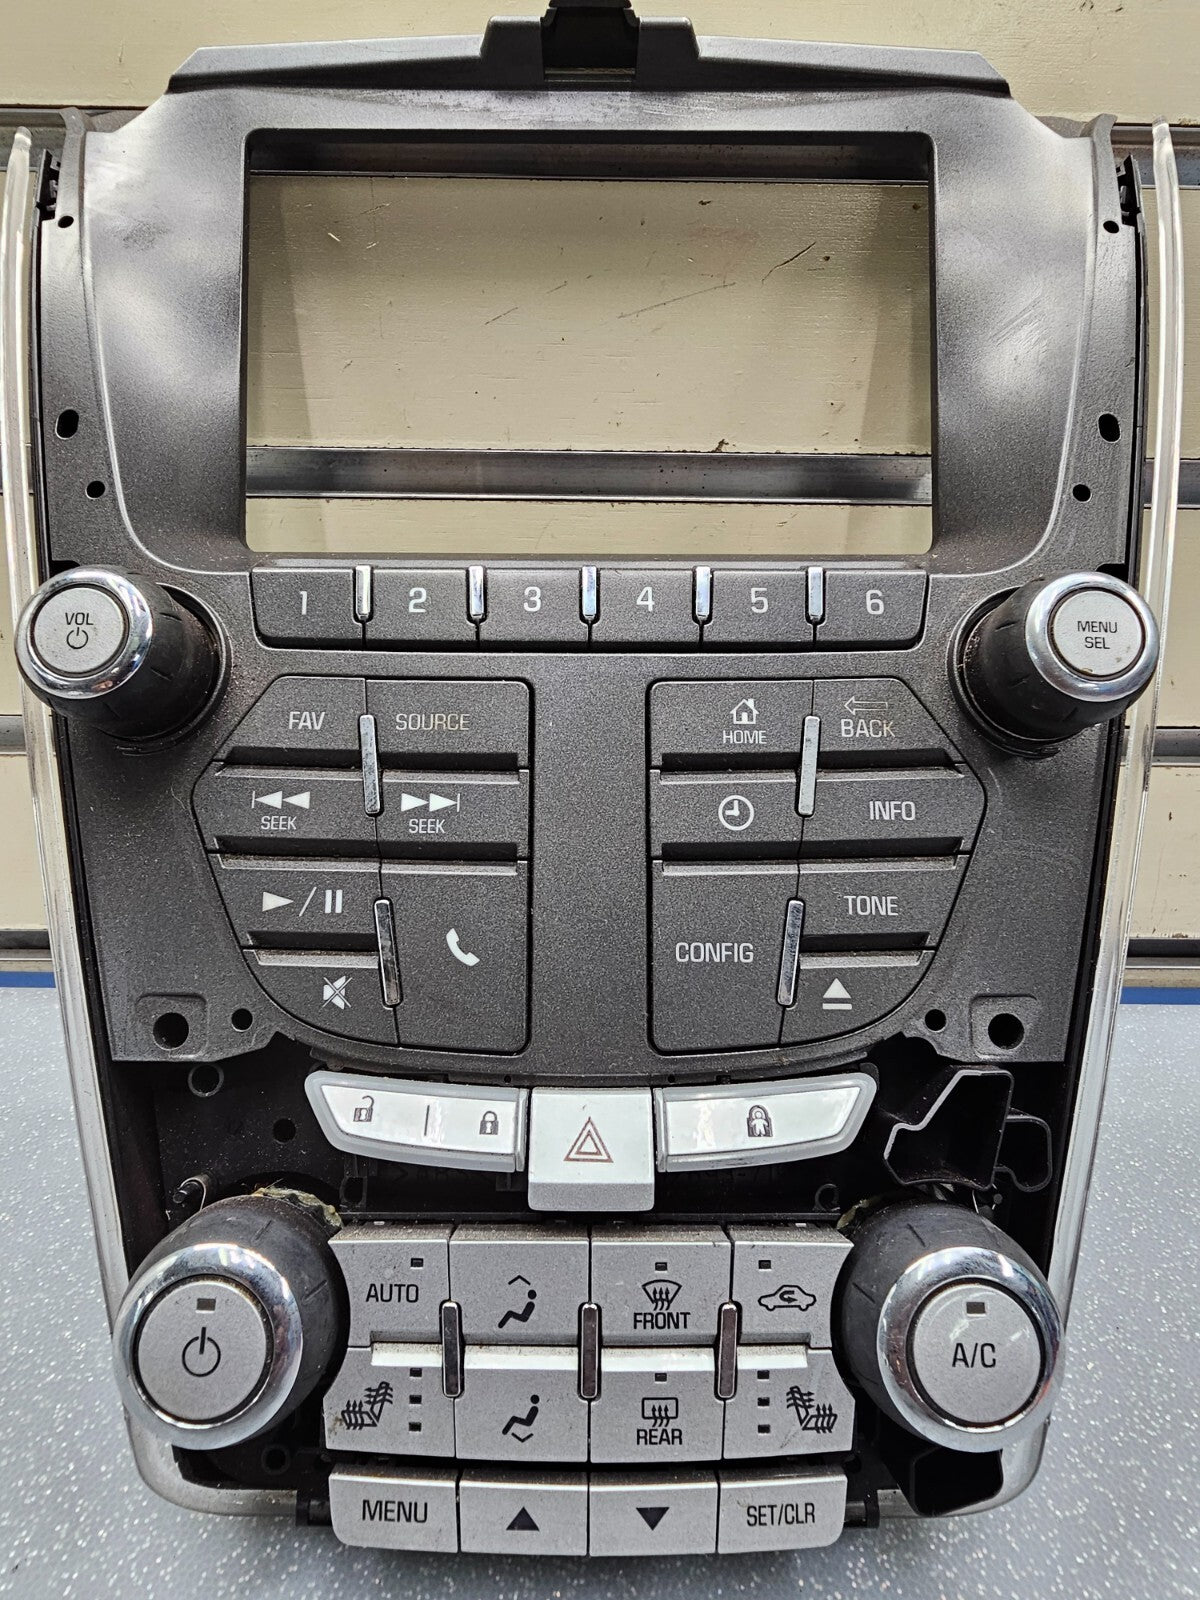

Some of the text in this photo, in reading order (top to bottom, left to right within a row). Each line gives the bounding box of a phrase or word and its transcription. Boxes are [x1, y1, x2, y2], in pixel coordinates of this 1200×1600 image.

[299, 590, 308, 615] 1
[409, 587, 427, 612] 2
[524, 587, 541, 611] 3
[637, 587, 654, 611] 4
[751, 587, 768, 613] 5
[866, 590, 884, 614] 6
[65, 612, 93, 625] VOL
[1077, 621, 1117, 633] MENU
[1085, 636, 1110, 649] SEL
[289, 711, 325, 730] FAV
[396, 713, 470, 730] SOURCE
[841, 719, 895, 737] BACK
[723, 730, 766, 744] HOME
[870, 801, 915, 820] INFO
[261, 816, 296, 830] SEEK
[409, 819, 445, 833] SEEK
[844, 896, 898, 915] TONE
[676, 942, 753, 962] CONFIG
[366, 1283, 419, 1303] AUTO
[633, 1312, 690, 1329] FRONT
[952, 1343, 996, 1368] A/C
[637, 1428, 682, 1445] REAR
[362, 1499, 427, 1523] MENU
[747, 1502, 815, 1527] SET/CLR
